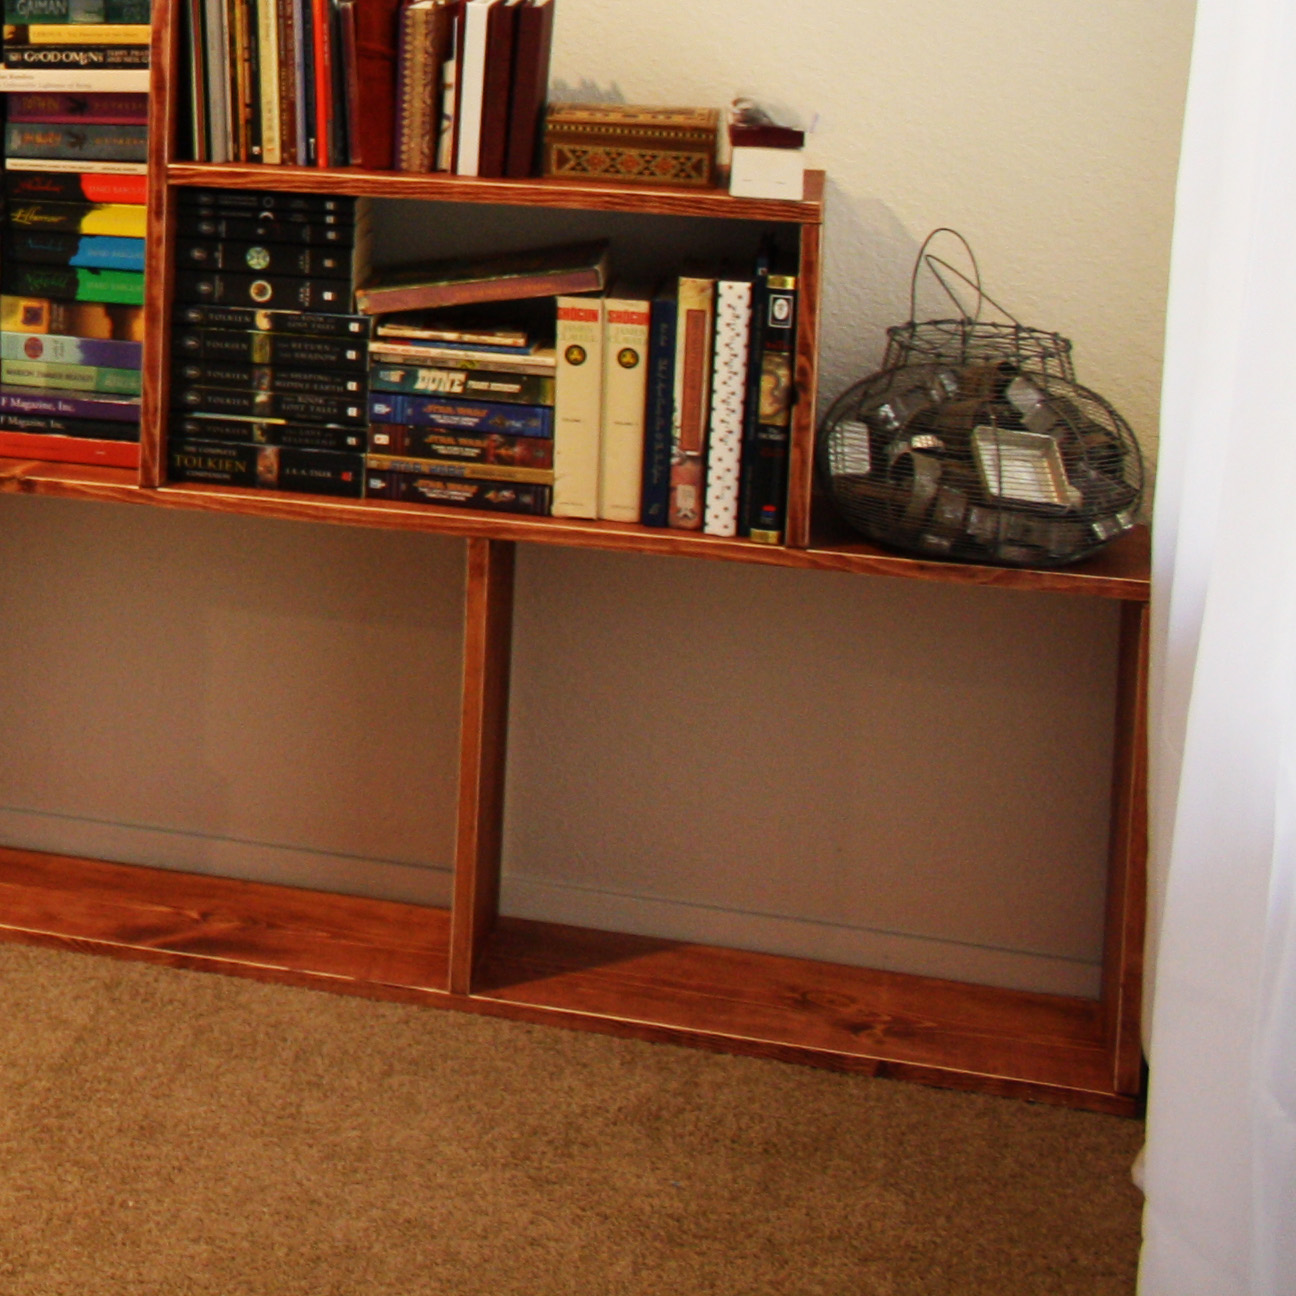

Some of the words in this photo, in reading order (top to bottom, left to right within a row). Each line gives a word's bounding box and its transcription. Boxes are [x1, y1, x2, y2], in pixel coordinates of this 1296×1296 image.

[209, 312, 251, 323] TOLKIEN
[206, 370, 249, 380] TOLKIEN
[413, 368, 468, 393] DUNE
[1, 397, 8, 406] F
[207, 395, 249, 406] TOLKIEN
[173, 453, 248, 473] TOLKIEN
